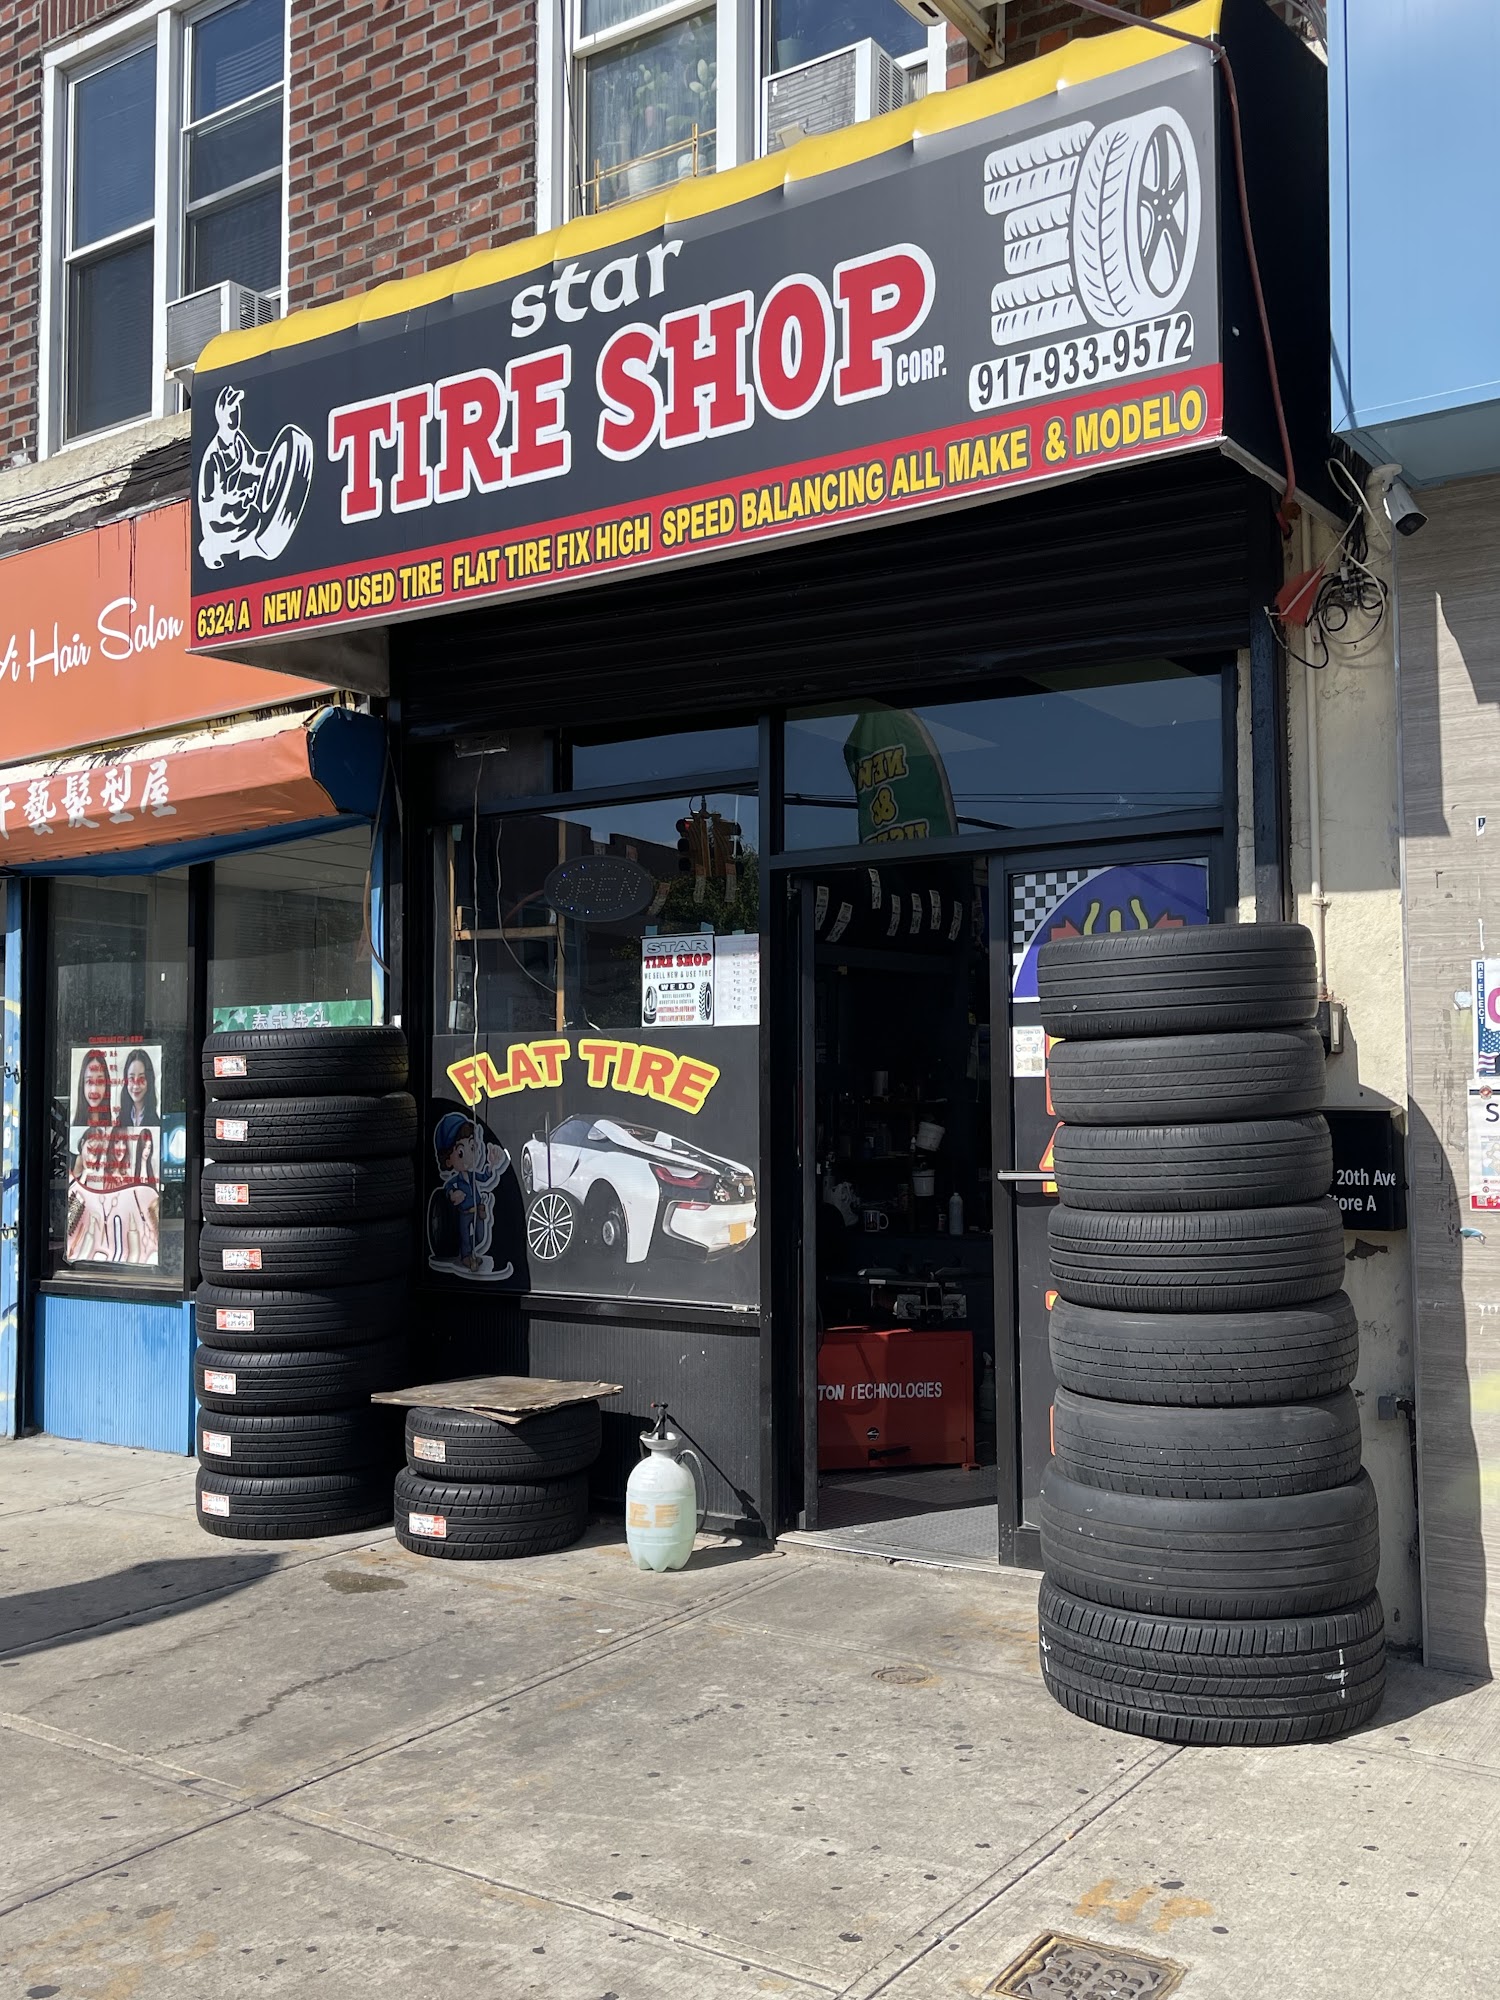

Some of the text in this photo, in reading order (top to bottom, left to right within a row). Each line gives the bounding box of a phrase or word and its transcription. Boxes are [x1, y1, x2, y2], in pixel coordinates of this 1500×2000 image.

[511, 239, 683, 338] star
[897, 345, 947, 387] CORP.
[977, 314, 1193, 406] 917-933-9572
[328, 243, 936, 524] TIRE SHOP
[197, 389, 1202, 638] 6324 A NEW AND USED TIRE FLAT TIRE FIX HIGH SPEED BALANCING ALL MAKE & MODELO
[26, 621, 91, 683] Hair
[97, 596, 184, 660] Salon
[555, 877, 641, 902] OPEN
[644, 952, 712, 969] TIRE SHOP
[647, 939, 708, 953] STAR
[661, 982, 693, 991] WE DO
[699, 969, 712, 977] TIRE
[447, 1039, 720, 1115] FLAT TIRE
[1336, 1168, 1397, 1186] 20th Ave
[1326, 1193, 1377, 1212] tore A
